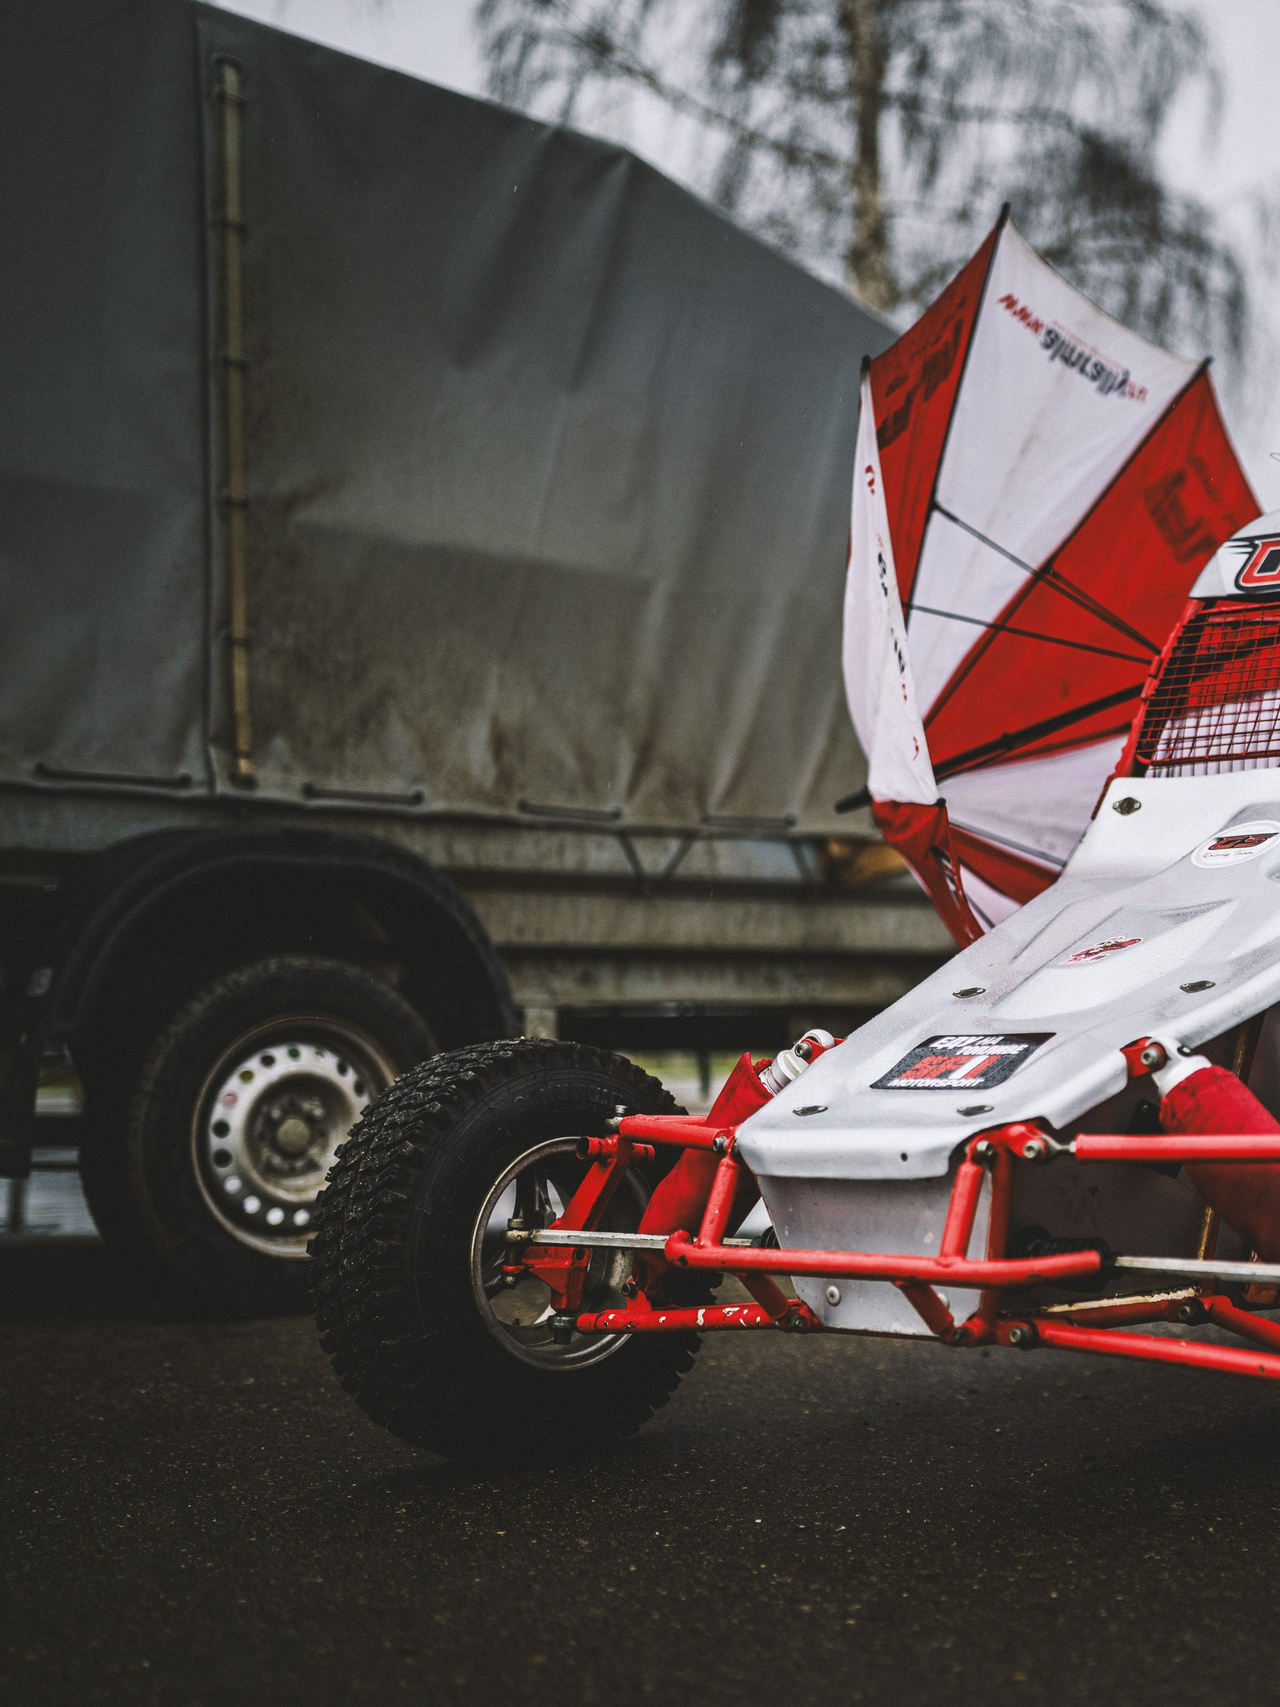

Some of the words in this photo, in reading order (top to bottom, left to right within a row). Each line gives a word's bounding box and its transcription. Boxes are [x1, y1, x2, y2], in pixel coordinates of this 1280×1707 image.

[1208, 832, 1278, 850] GS
[929, 1036, 986, 1049] ЕДУ
[888, 1078, 985, 1087] MOTORSPORT
